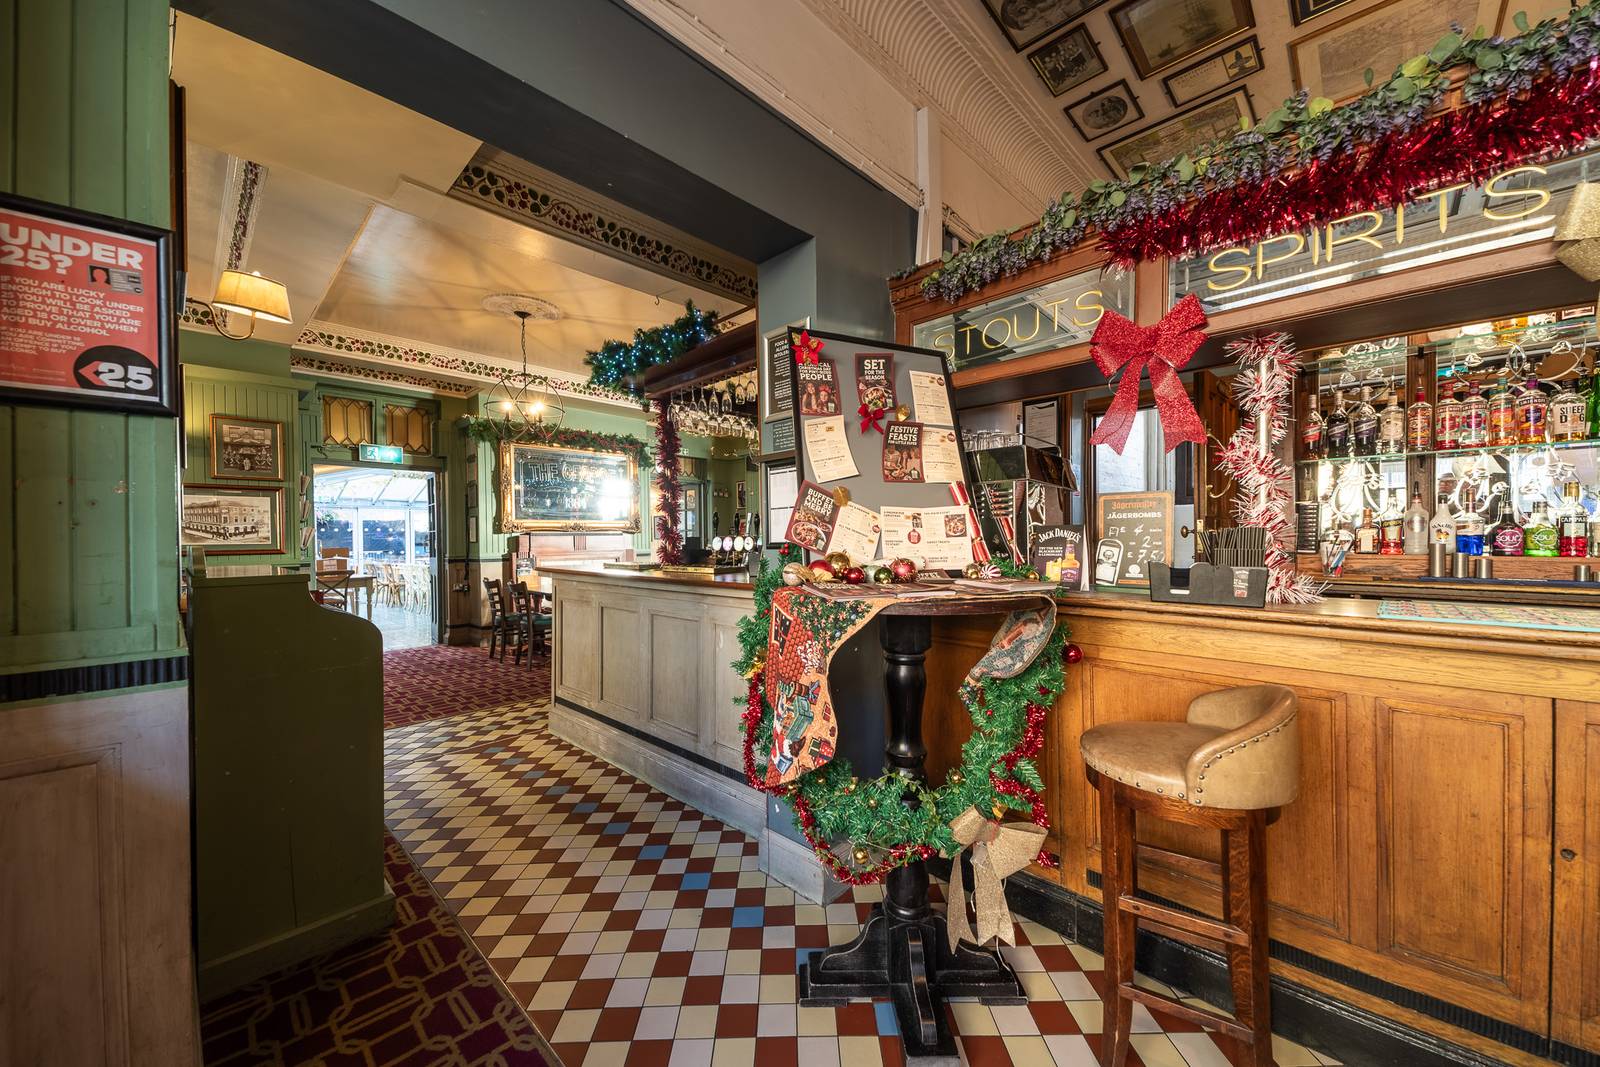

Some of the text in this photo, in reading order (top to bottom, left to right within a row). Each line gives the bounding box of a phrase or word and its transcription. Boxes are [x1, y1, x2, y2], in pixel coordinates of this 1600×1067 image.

[1207, 165, 1551, 291] SPIRITS
[1, 222, 144, 270] UNDER
[0, 245, 73, 275] 25?
[15, 277, 39, 286] YOU
[41, 281, 65, 291] ARE
[68, 287, 106, 299] LUCKY
[0, 283, 144, 313] ENOUGH TO LOOK UNDER
[1, 291, 130, 317] 25 YOU WILL BE ASKED
[0, 307, 138, 333] AGED 18 OR OVER WHEN
[1, 298, 142, 327] TO PROVE THAT YOU ARE
[1, 314, 110, 336] YOU BUY ALCOHOL
[933, 290, 1105, 360] STOUTS
[864, 359, 885, 370] SET
[1560, 414, 1585, 423] DG
[889, 432, 917, 442] FEASTS
[890, 425, 918, 434] FESTIVE
[805, 495, 822, 506] AND
[808, 488, 834, 505] BUFFET
[803, 500, 832, 517] MERRY
[1106, 511, 1162, 519] JÄGERBOMBS
[1038, 527, 1082, 543] JACK DANIEL'S
[1142, 536, 1151, 548] 2
